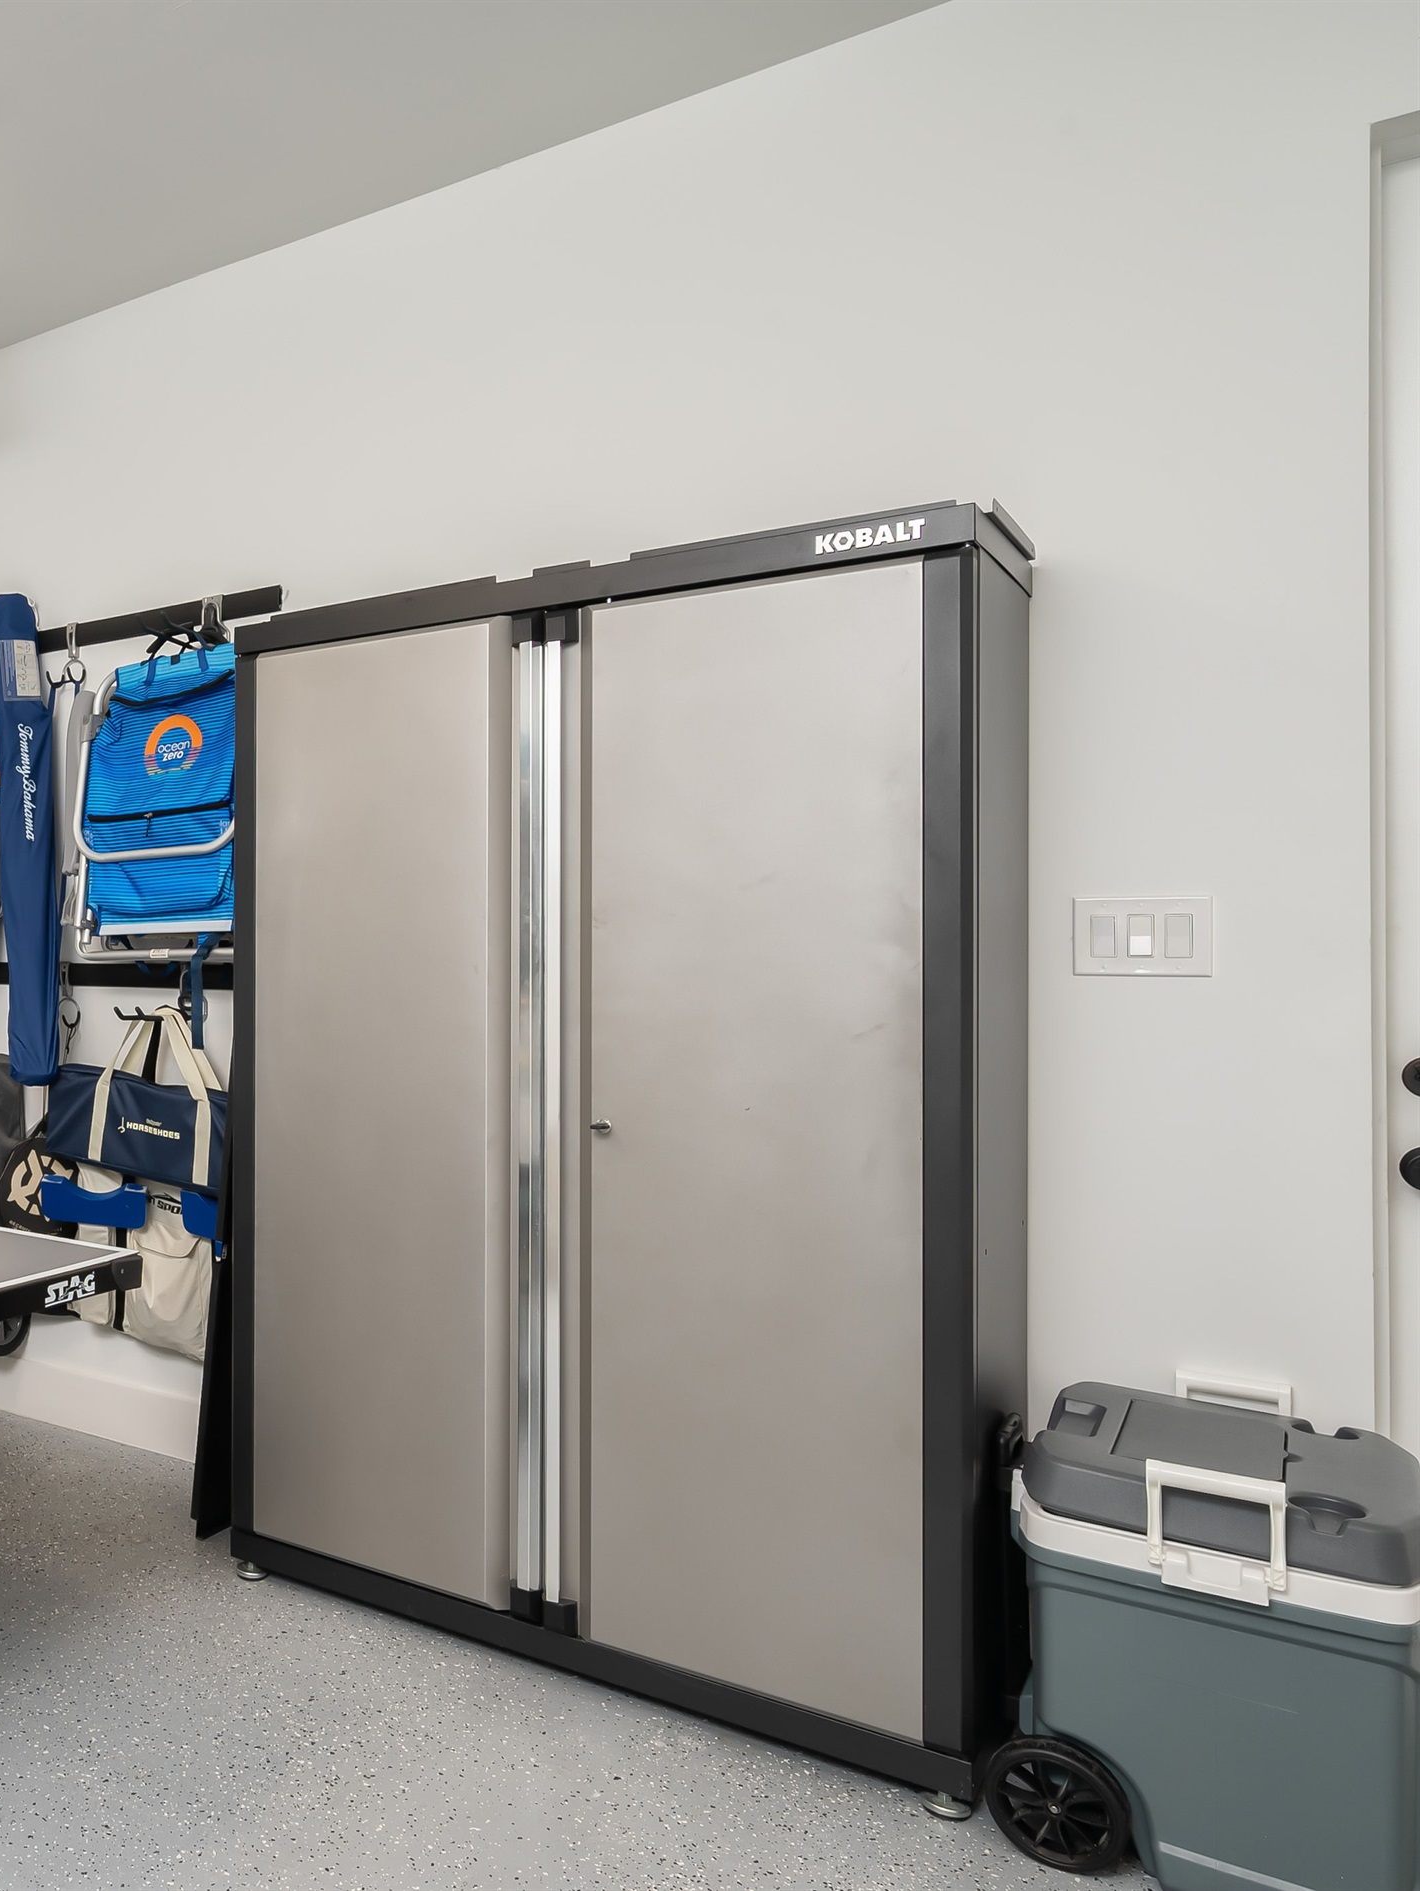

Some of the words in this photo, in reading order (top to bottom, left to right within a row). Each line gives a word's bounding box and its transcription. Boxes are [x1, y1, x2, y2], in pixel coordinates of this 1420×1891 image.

[815, 518, 926, 555] KOBALT
[16, 723, 33, 779] Tommy
[158, 740, 190, 753] ocean
[162, 750, 184, 762] zero
[22, 779, 36, 842] Bahama
[126, 1121, 181, 1140] HORSESHOES
[157, 1200, 183, 1214] SPO
[45, 1273, 96, 1307] STAG
